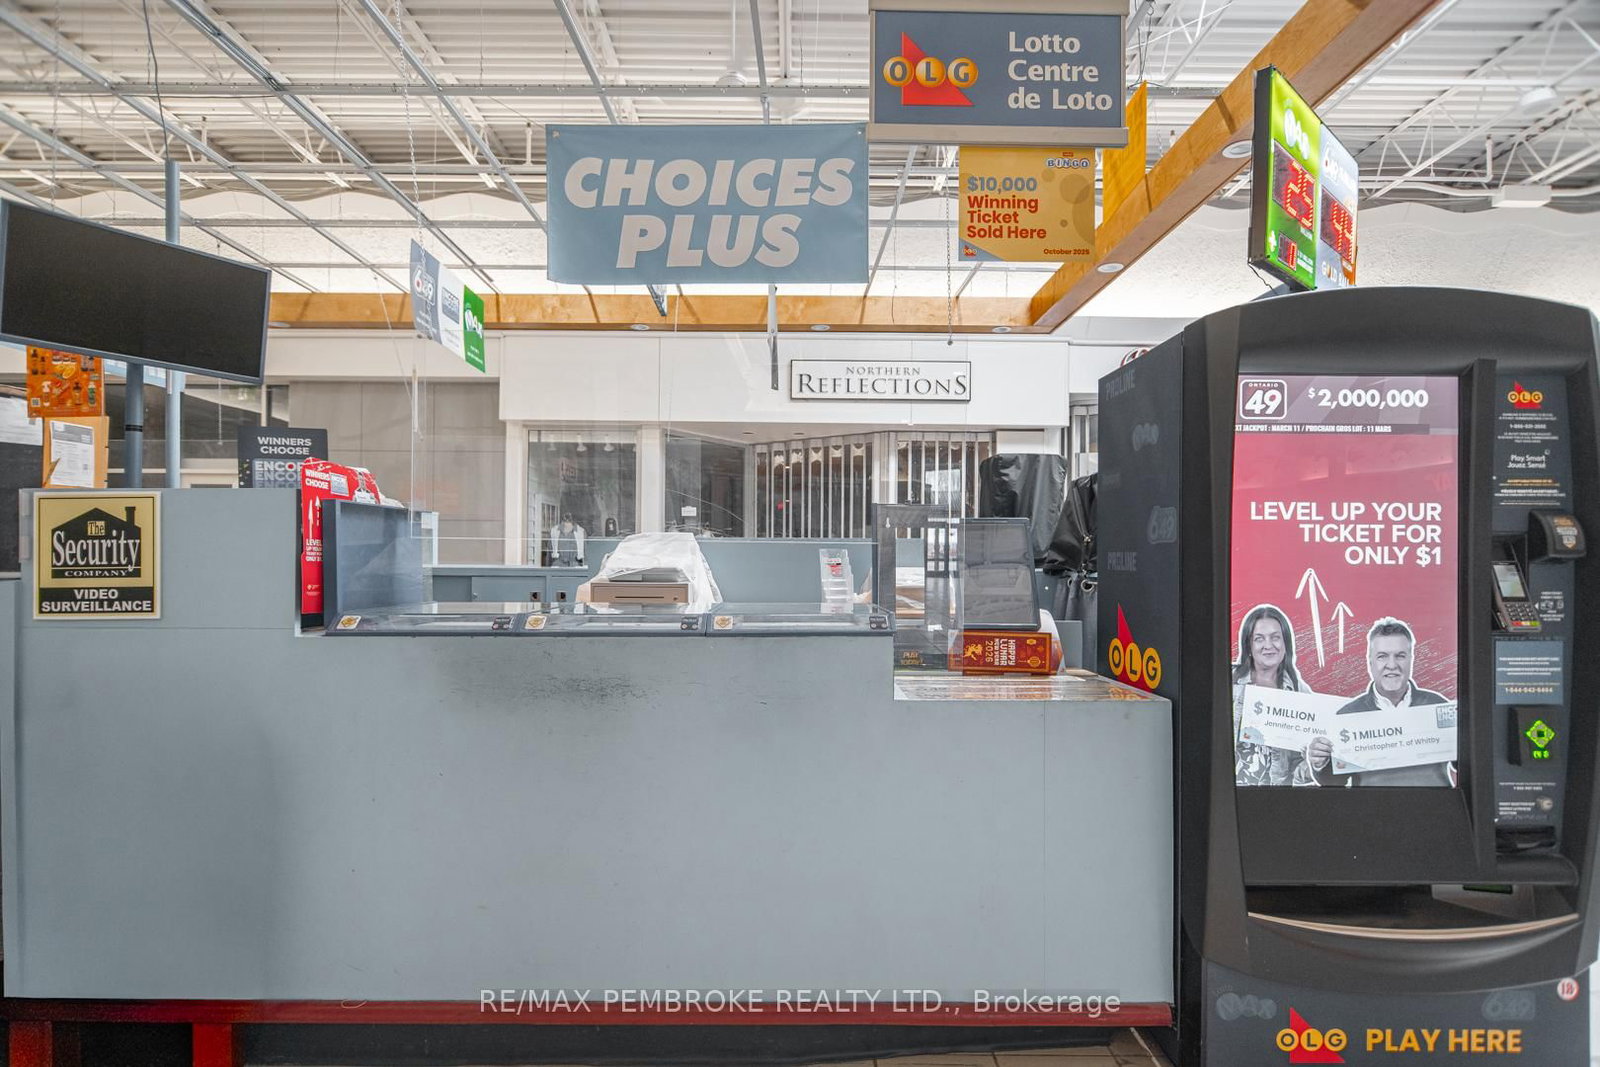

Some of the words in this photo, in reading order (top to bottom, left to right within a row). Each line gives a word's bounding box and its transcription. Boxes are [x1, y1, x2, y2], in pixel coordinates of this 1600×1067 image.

[1008, 31, 1080, 53] Lotto
[885, 58, 976, 86] OLG
[1008, 60, 1098, 83] Centre
[1008, 89, 1040, 110] de
[1052, 89, 1112, 111] Loto
[1047, 158, 1090, 168] BINGO
[564, 158, 855, 208] CHOICES
[968, 176, 1037, 194] $10,000
[968, 195, 1038, 213] Winning
[967, 210, 1019, 224] Ticket
[967, 225, 1003, 238] Sold
[1008, 226, 1047, 238] Here
[616, 215, 802, 268] PLUS
[846, 366, 922, 376] NORTHERN
[798, 374, 968, 398] REFLECTIONS
[1245, 390, 1282, 414] 49
[1308, 389, 1428, 409] $2,000,000
[1508, 391, 1543, 403] OLG
[258, 436, 312, 446] WINNERS
[260, 446, 310, 455] CHOOSE
[305, 469, 330, 481] WINNERS
[305, 478, 329, 490] CHOOSE
[1250, 502, 1324, 520] LEVEL
[1332, 502, 1366, 520] UP
[1372, 502, 1442, 521] YOUR
[88, 521, 106, 535] The
[1300, 524, 1384, 542] TICKET
[1392, 525, 1442, 543] FOR
[53, 530, 140, 572] Security
[1344, 546, 1410, 565] ONLY
[1416, 544, 1442, 567] $1
[74, 589, 118, 599] VIDEO
[42, 601, 152, 612] SURVEILLANCE
[986, 640, 994, 662] 2026
[1008, 639, 1016, 666] HAPPY
[1110, 641, 1160, 686] OLG
[1254, 700, 1263, 715] $
[1272, 707, 1316, 722] MILLION
[1264, 719, 1293, 730] Jennifer
[1340, 728, 1350, 743] $
[1359, 727, 1403, 740] MILLION
[1355, 742, 1397, 752] Christopher
[1415, 736, 1440, 745] Whitby
[1278, 1030, 1346, 1050] OLG
[1366, 1029, 1440, 1051] PLAY
[1449, 1030, 1522, 1052] HERE
